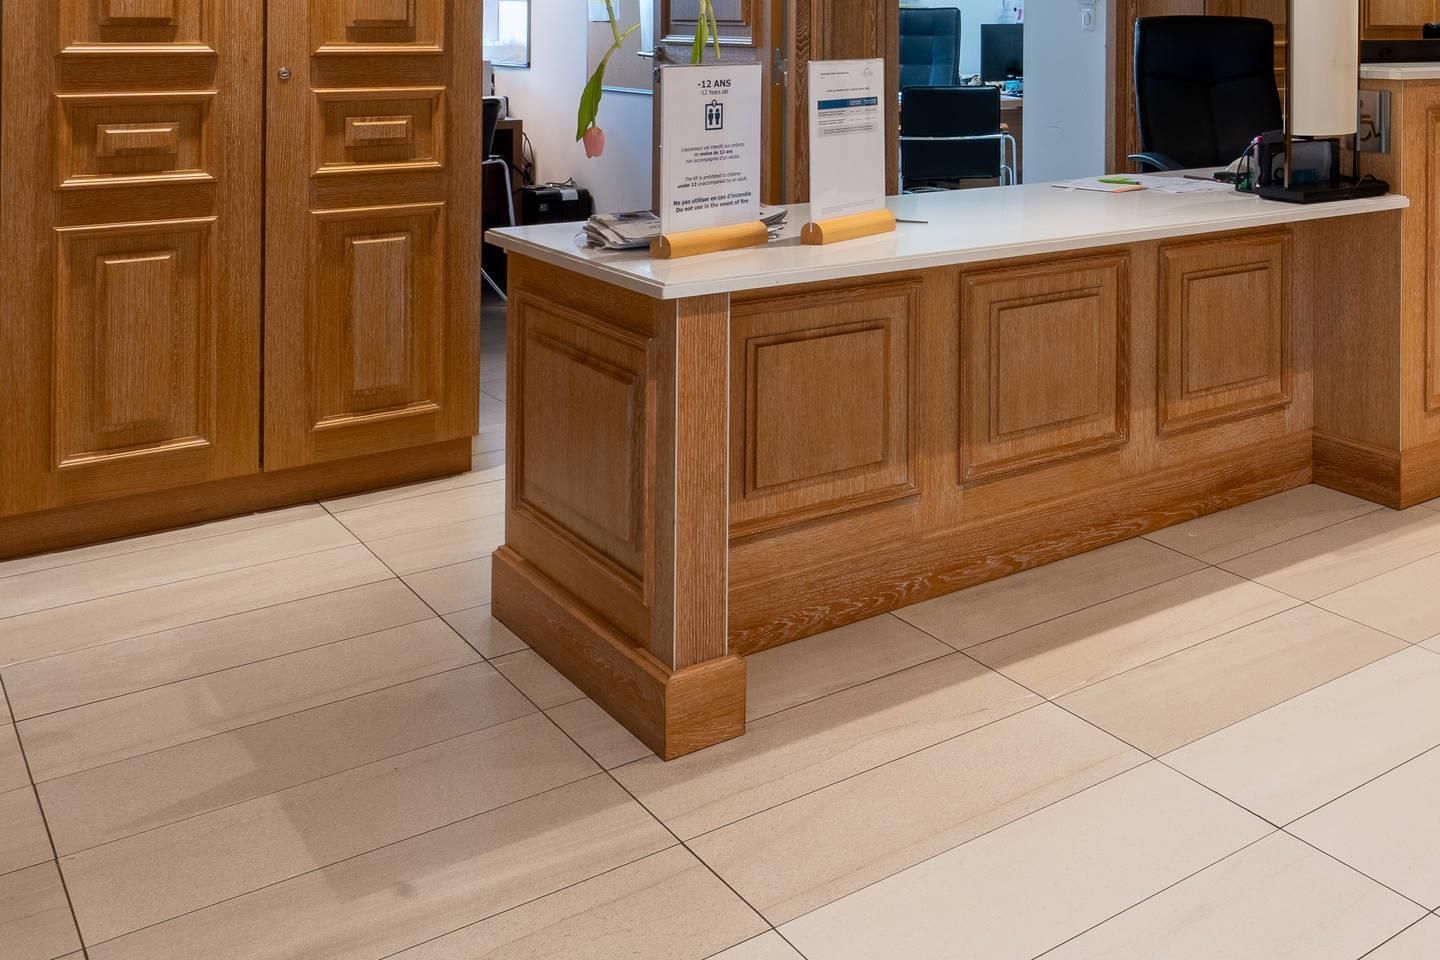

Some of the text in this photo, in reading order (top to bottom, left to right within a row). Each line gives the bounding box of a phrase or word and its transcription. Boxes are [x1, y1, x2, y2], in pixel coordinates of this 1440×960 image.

[697, 79, 732, 88] -12 ANS
[727, 191, 752, 199] d'incendie
